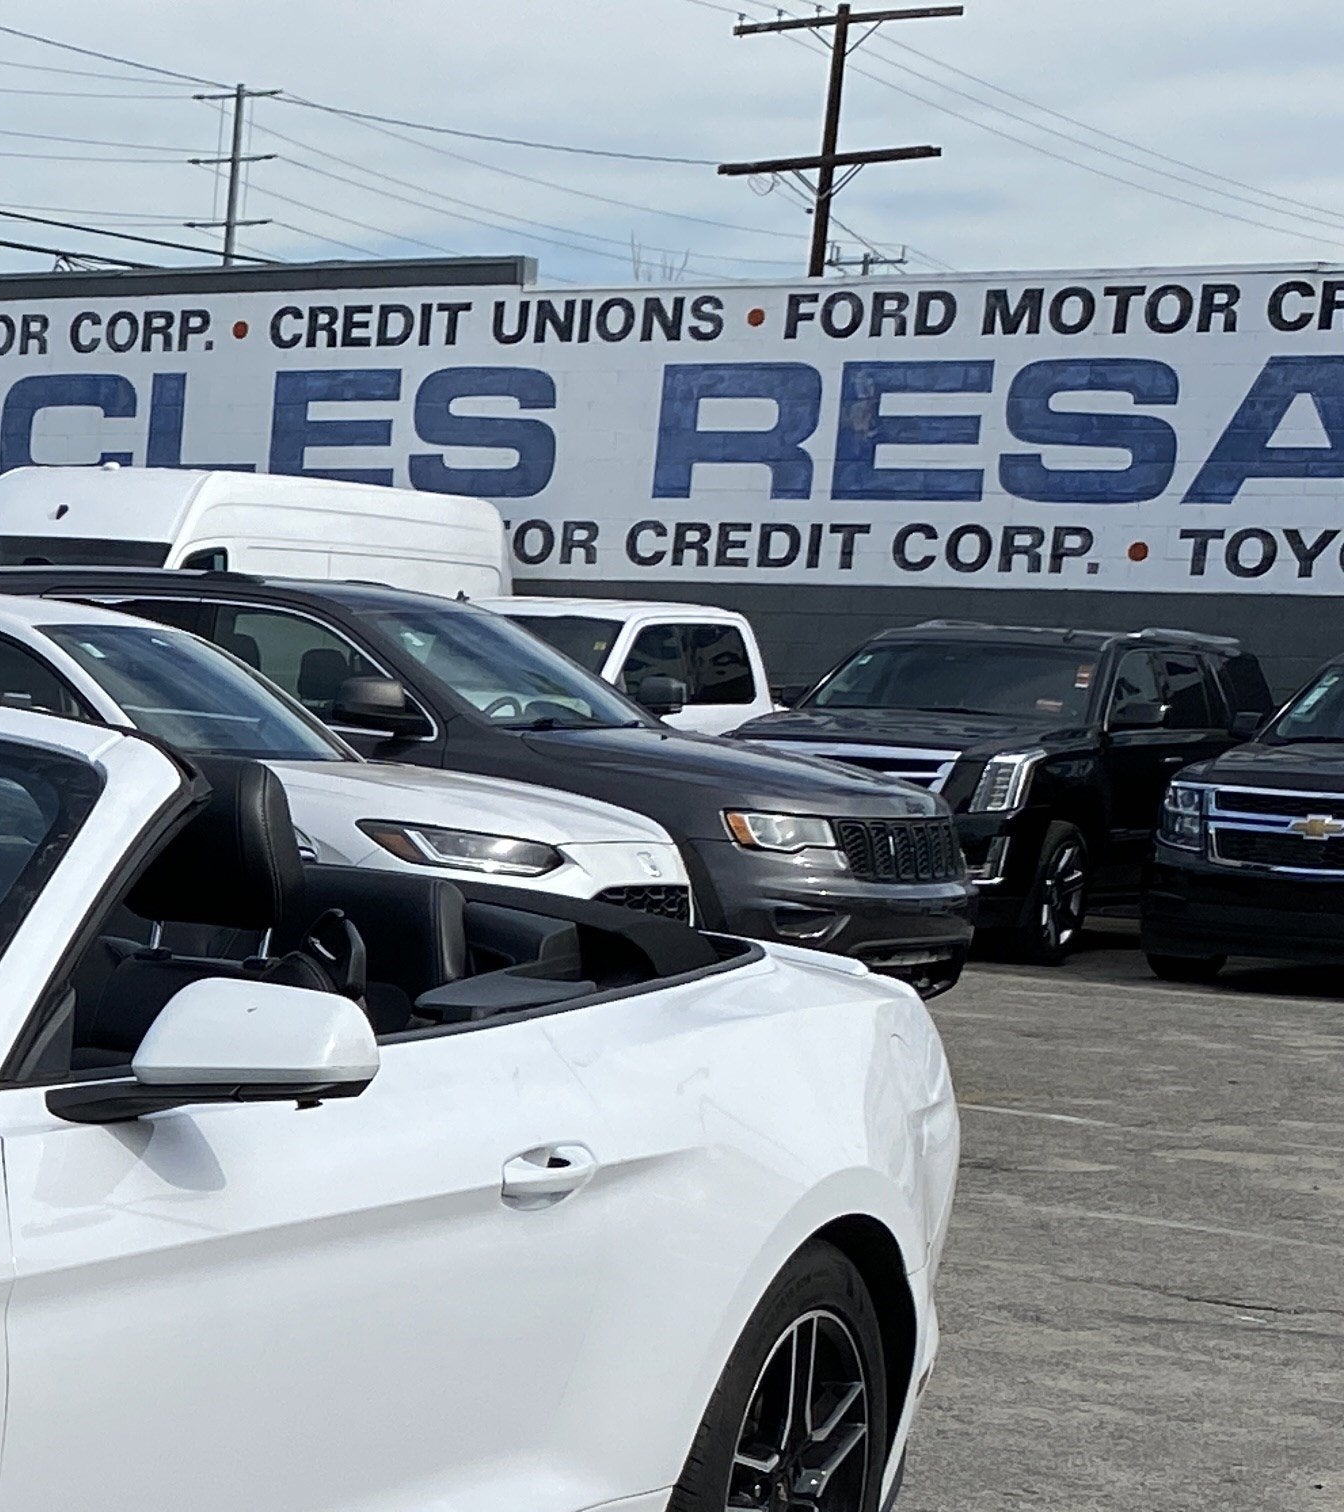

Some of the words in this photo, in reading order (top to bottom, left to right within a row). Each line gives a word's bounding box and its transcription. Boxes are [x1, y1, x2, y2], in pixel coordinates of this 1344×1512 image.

[69, 309, 214, 354] CORP.
[269, 301, 473, 348] CREDIT
[492, 295, 724, 345] UNIONS
[783, 290, 957, 340] FORD
[981, 284, 1241, 336] MOTOR
[651, 354, 1344, 505] RESA
[503, 518, 599, 565] OR
[625, 520, 872, 570] CREDIT
[891, 523, 1100, 575] CORP.
[1179, 527, 1344, 579] TOY
